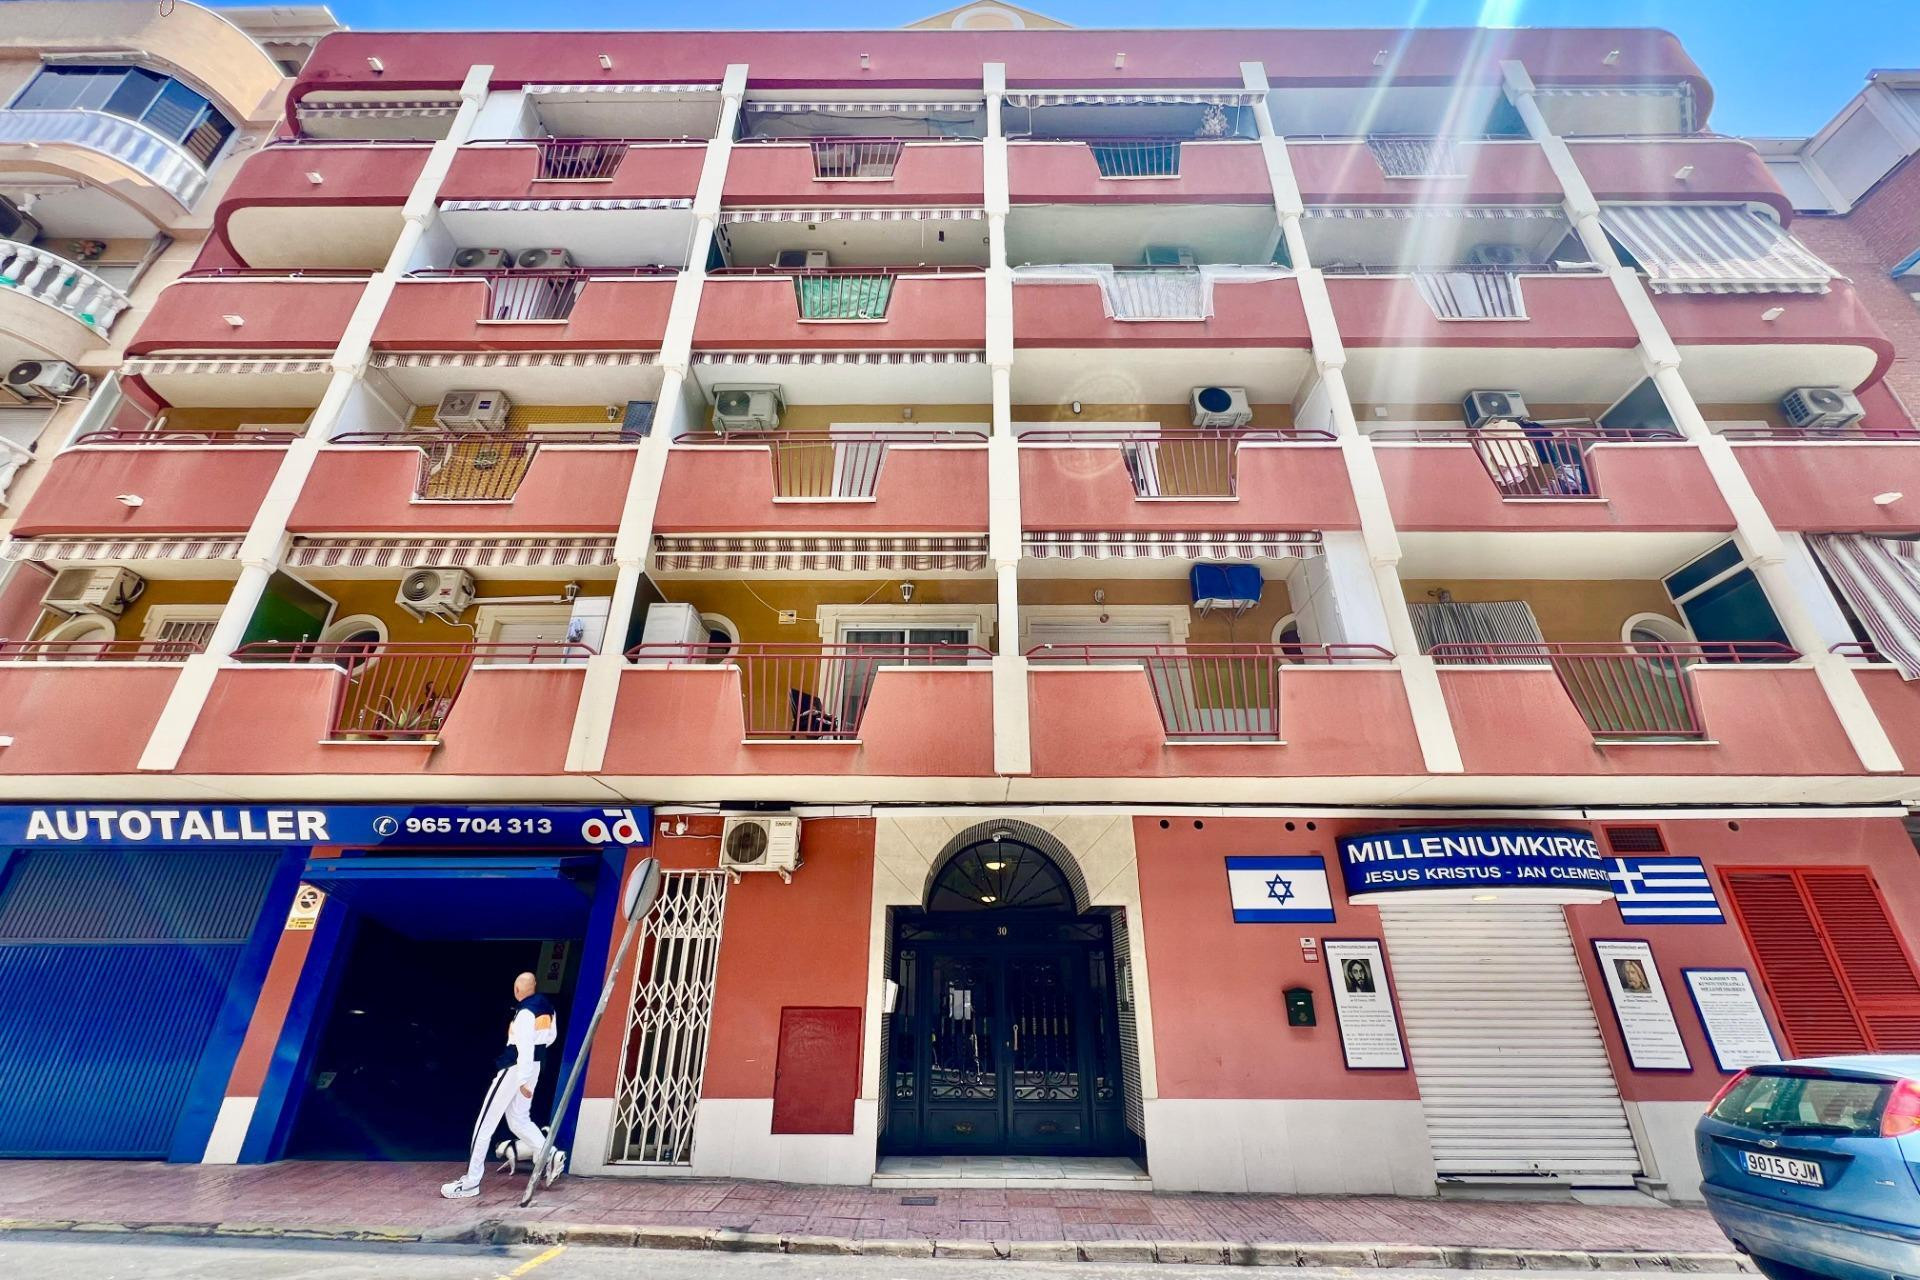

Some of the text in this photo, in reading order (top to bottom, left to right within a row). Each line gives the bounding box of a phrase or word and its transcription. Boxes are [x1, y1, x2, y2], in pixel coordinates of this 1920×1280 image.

[26, 810, 330, 841] AUTOTALLER
[406, 818, 552, 833] 965 704 313
[1365, 867, 1420, 884] JESUS
[1425, 866, 1502, 880] KRISTUS
[1516, 866, 1548, 879] JAN
[997, 926, 1007, 936] 30
[1748, 1154, 1785, 1175] 9015
[1788, 1161, 1819, 1181] CJM
